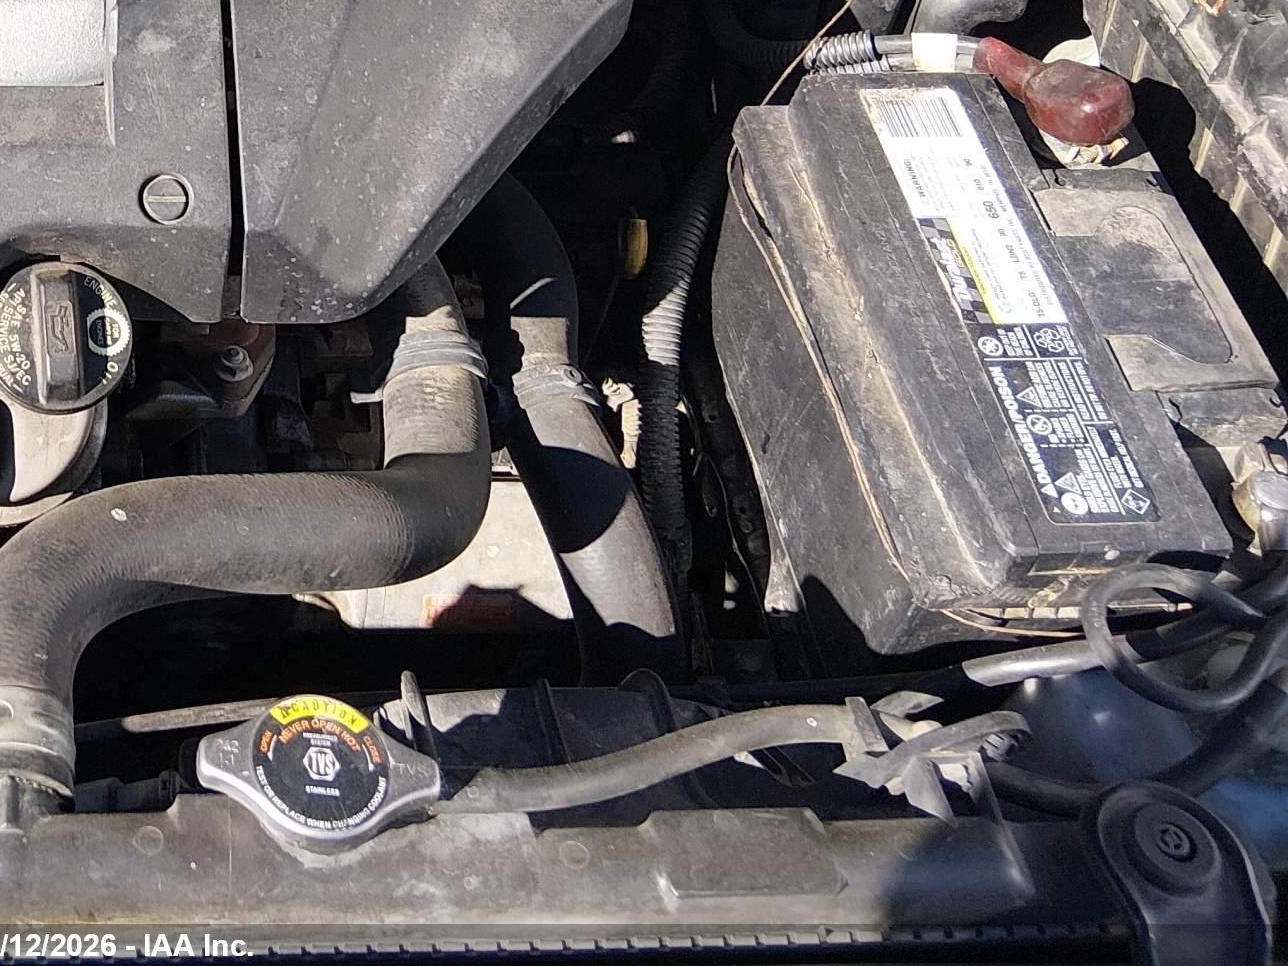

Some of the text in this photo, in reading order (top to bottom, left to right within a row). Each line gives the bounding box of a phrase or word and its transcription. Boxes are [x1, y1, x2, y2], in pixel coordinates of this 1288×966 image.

[980, 200, 1000, 218] 650
[929, 236, 973, 300] Duralast
[84, 276, 117, 309] ENGINE
[1057, 362, 1091, 419] READ INSTRUCTIONS
[988, 366, 1052, 483] DANGER/POISON
[291, 699, 358, 724] CAUTION
[257, 729, 273, 754] OPEN
[279, 718, 361, 752] NEVER OPEN HOT
[362, 734, 383, 765] CLOSE
[309, 752, 335, 775] TVS
[271, 796, 306, 823] REPLACE
[306, 817, 332, 829] WHEN
[332, 808, 370, 828] CHANGING
[367, 775, 387, 811] COOLANT
